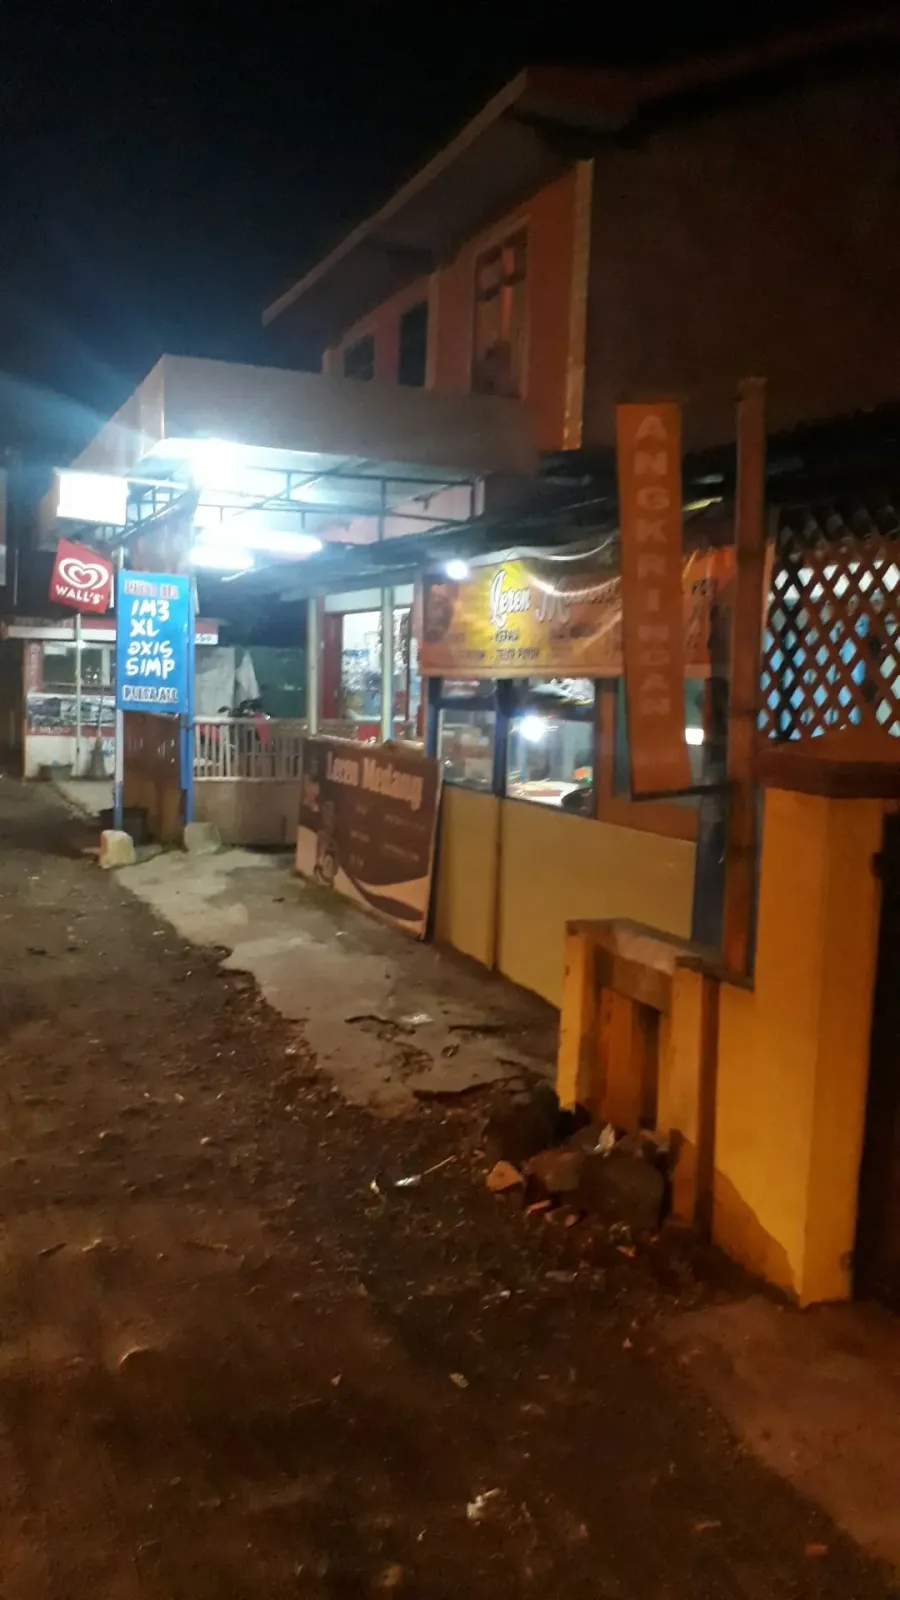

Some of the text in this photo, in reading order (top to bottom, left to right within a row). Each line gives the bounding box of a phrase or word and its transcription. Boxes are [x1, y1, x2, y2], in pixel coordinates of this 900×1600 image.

[633, 415, 671, 717] ANGKRINGAN
[55, 585, 102, 605] WALL'S
[131, 599, 170, 622] IM3
[129, 617, 160, 638] XL
[126, 657, 176, 679] SIMP
